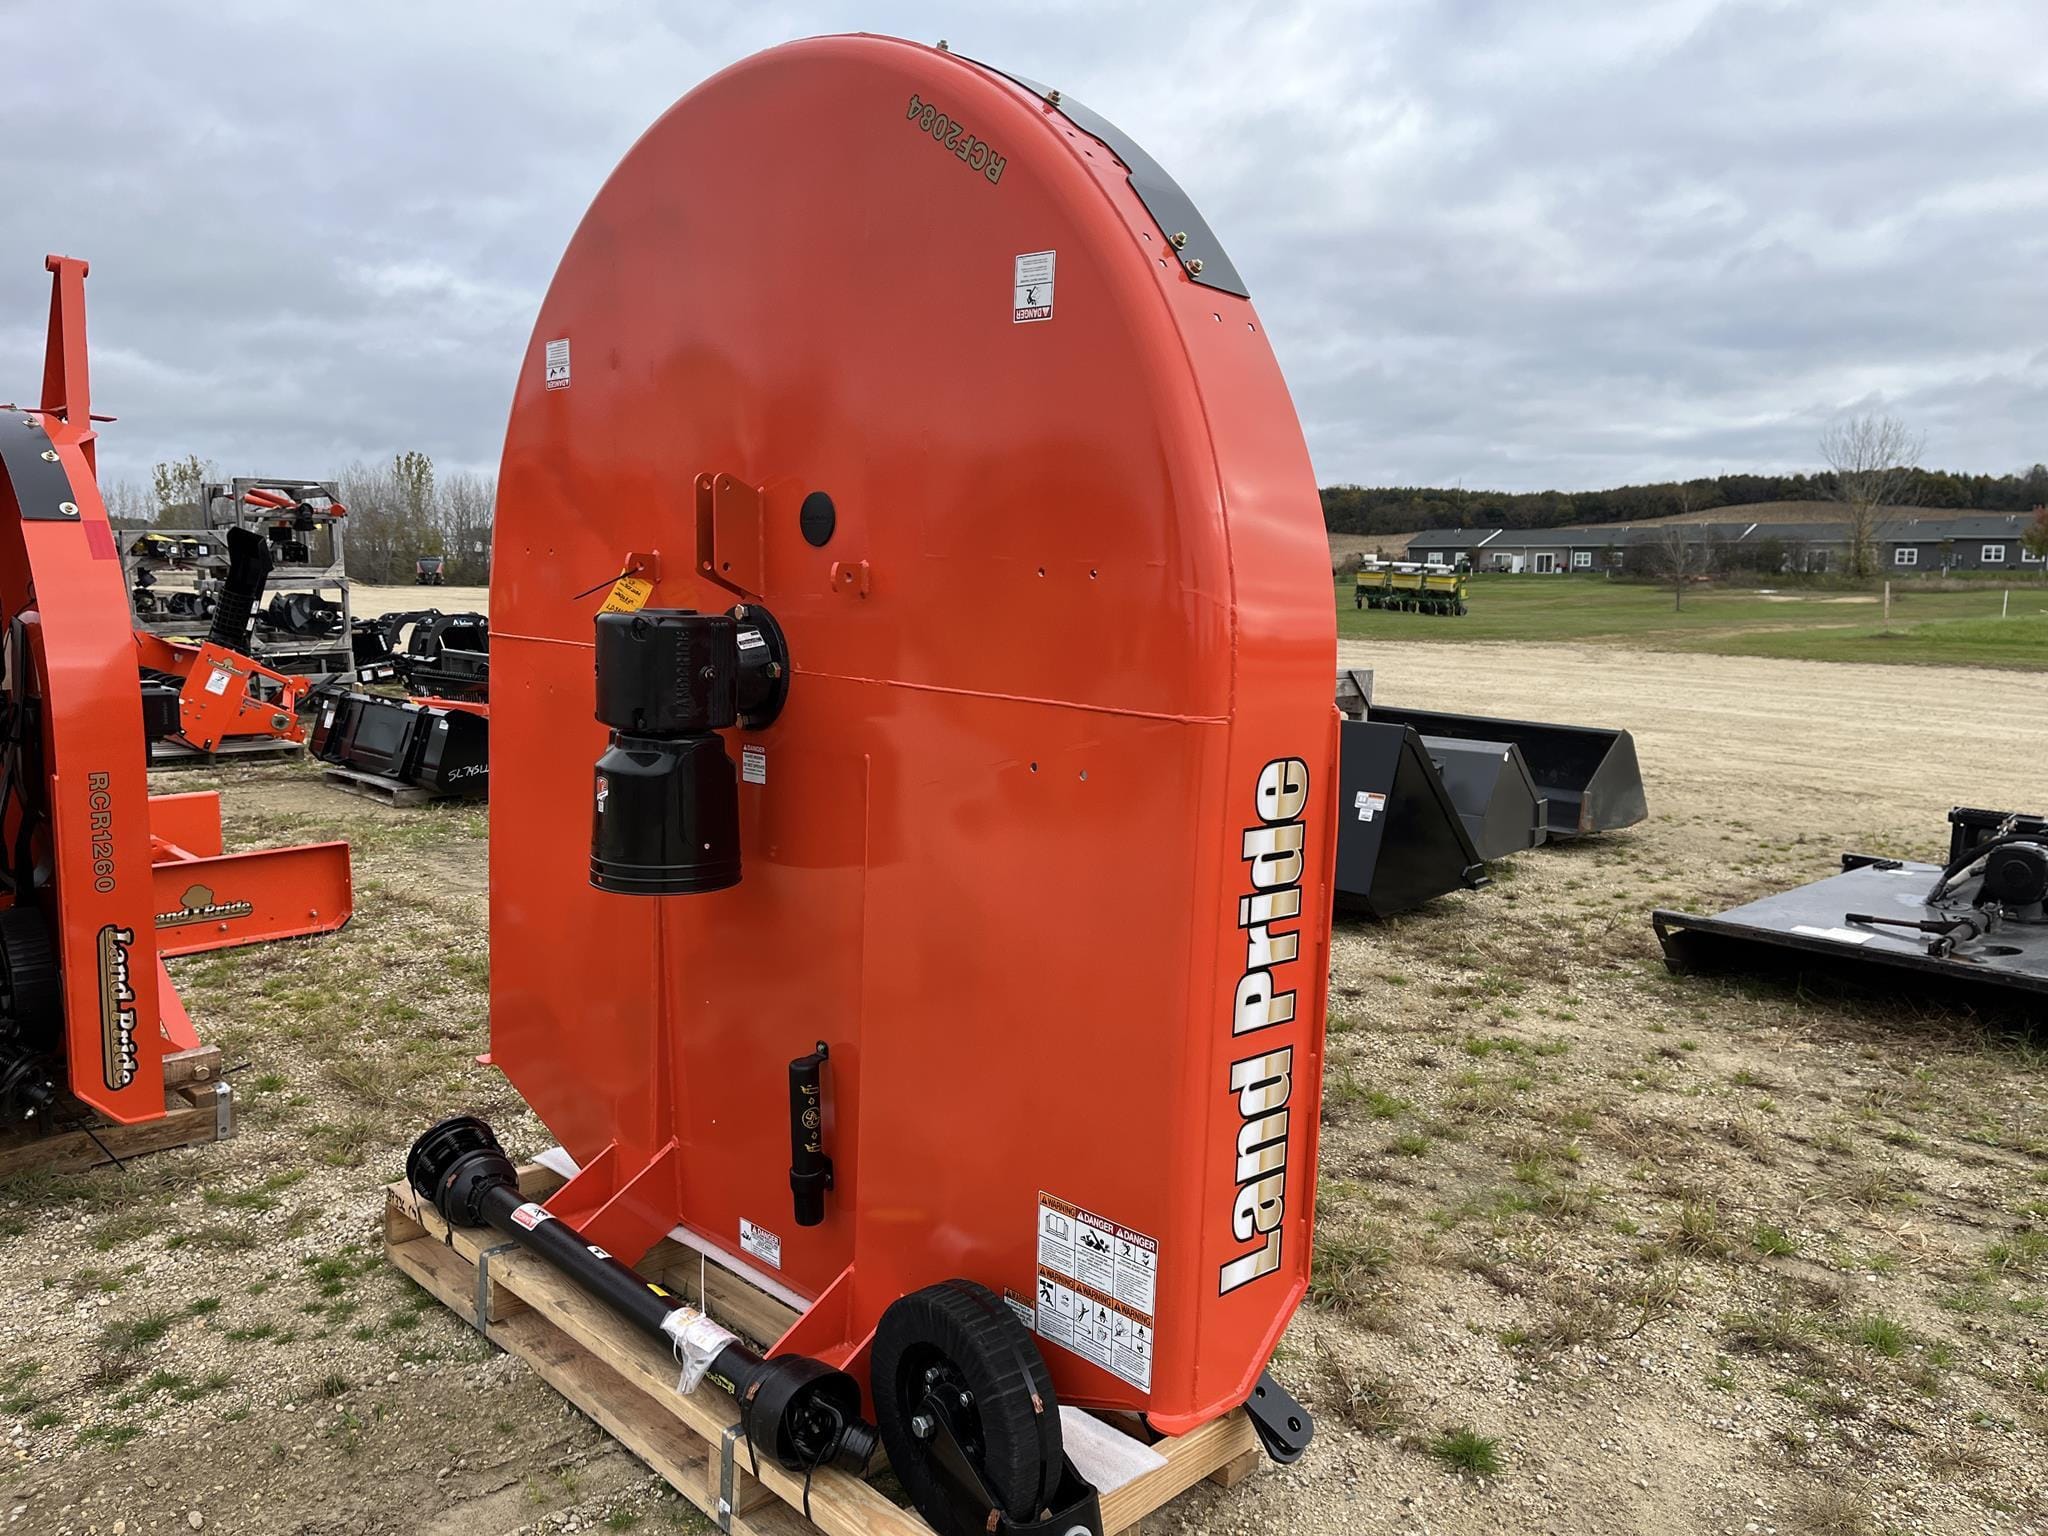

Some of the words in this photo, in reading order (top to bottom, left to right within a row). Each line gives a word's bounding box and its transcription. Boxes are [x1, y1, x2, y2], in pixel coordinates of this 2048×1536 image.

[906, 94, 1008, 185] RCF2084
[1016, 307, 1042, 320] DANGER
[88, 772, 116, 893] RCR1260
[1232, 757, 1309, 1038] Pride
[155, 905, 192, 922] and
[203, 900, 252, 918] Pride
[108, 928, 134, 1001] Land
[111, 1009, 137, 1086] Pride
[1219, 1045, 1294, 1298] Land
[1047, 1197, 1075, 1216] WARNING
[1083, 1214, 1114, 1234] DANGER
[1124, 1230, 1155, 1250] DANGER
[1045, 1269, 1074, 1289] WARNING
[1082, 1286, 1112, 1305] WARNING
[1121, 1305, 1151, 1326] WARNING
